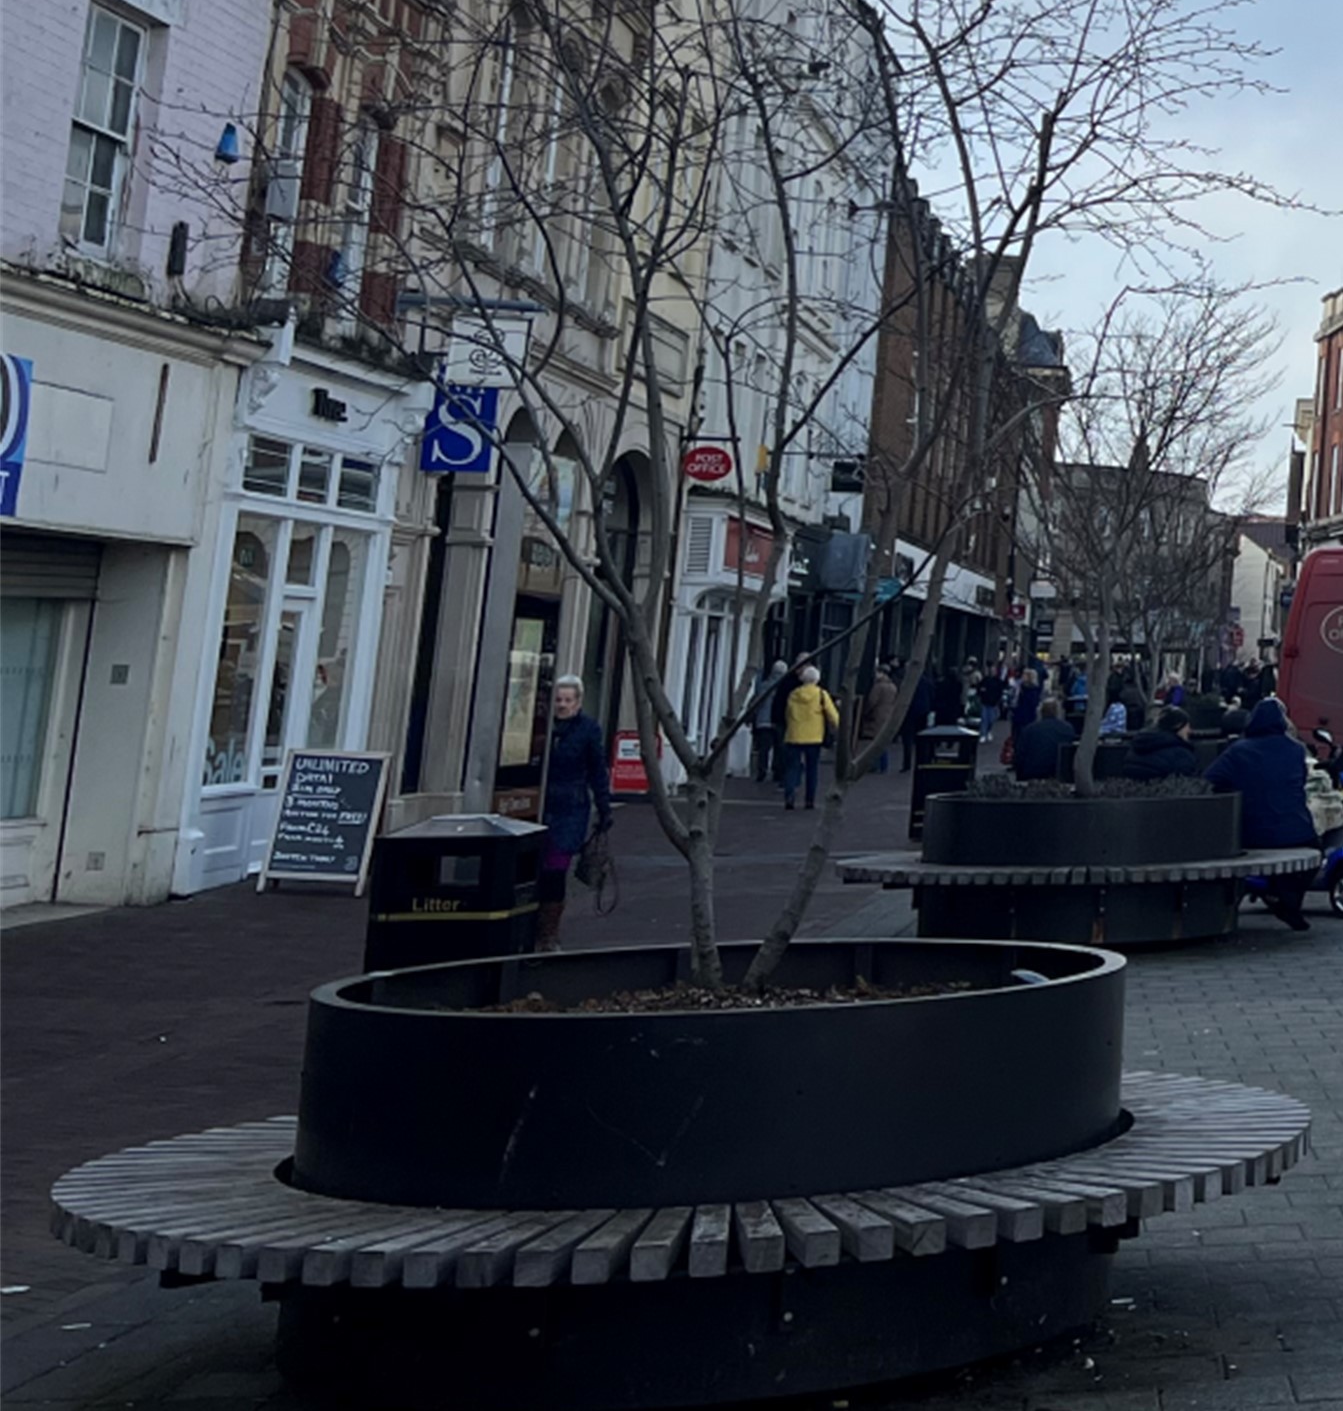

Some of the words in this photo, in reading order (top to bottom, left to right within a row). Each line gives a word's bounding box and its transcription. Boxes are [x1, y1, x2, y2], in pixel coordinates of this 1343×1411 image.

[695, 453, 724, 463] POST
[686, 463, 727, 474] OFFICE
[296, 757, 370, 775] UNLIMITED
[412, 897, 461, 912] Litter
